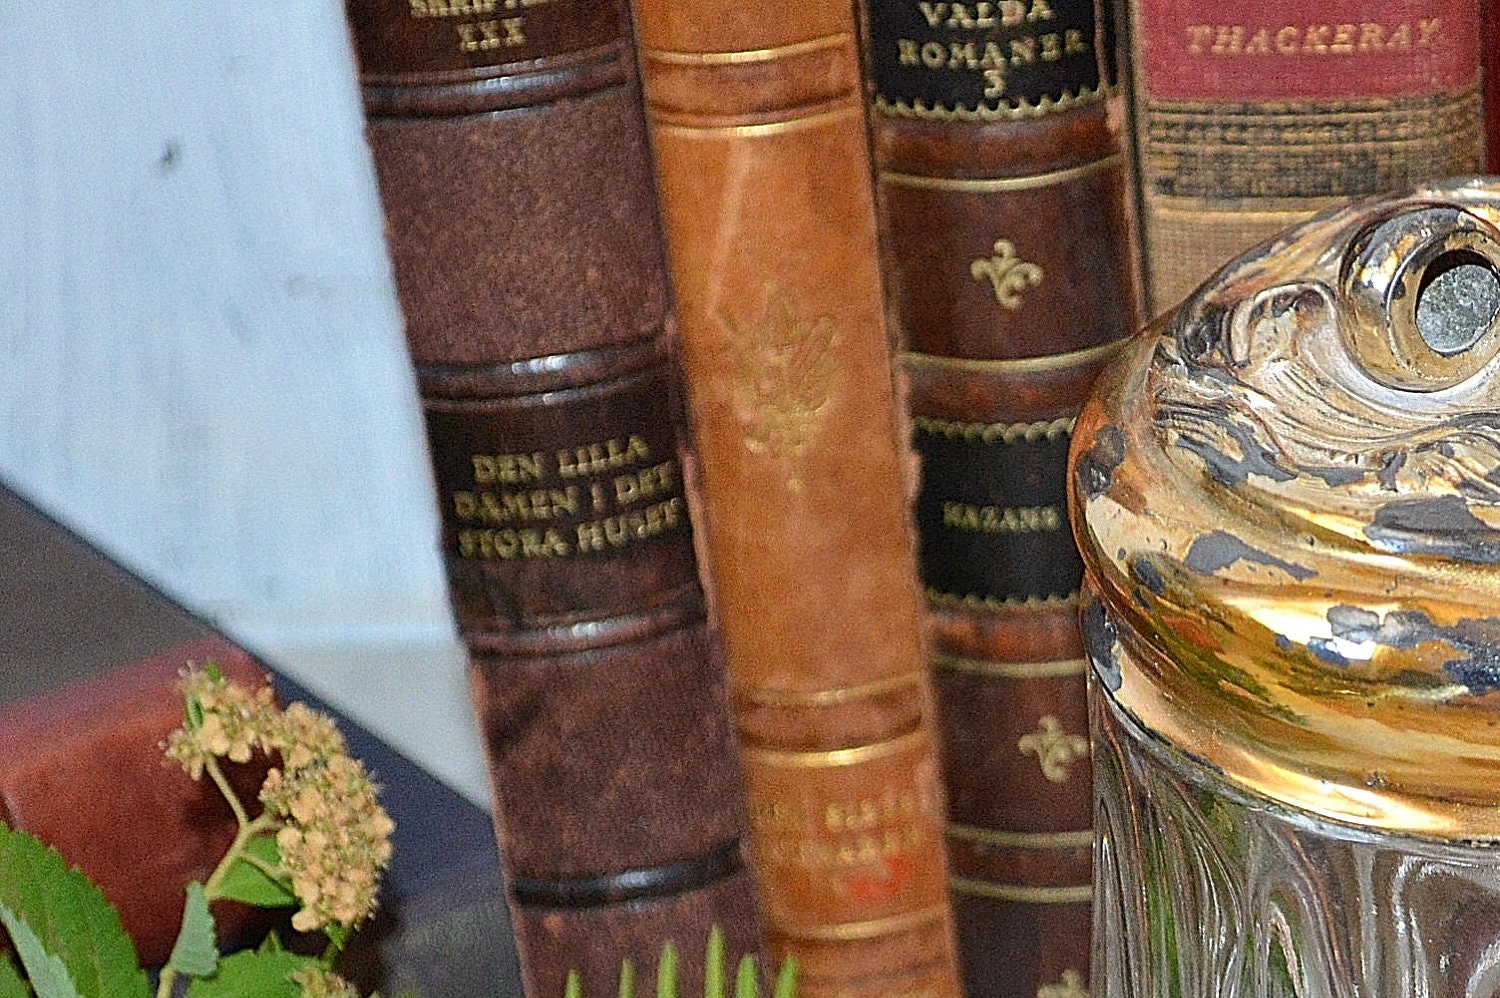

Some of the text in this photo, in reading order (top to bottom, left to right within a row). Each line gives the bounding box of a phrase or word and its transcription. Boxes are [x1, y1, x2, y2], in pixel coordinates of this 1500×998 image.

[898, 29, 1089, 69] ROMANER
[1187, 17, 1442, 54] THACKERAY
[472, 434, 649, 485] DEN LILLA
